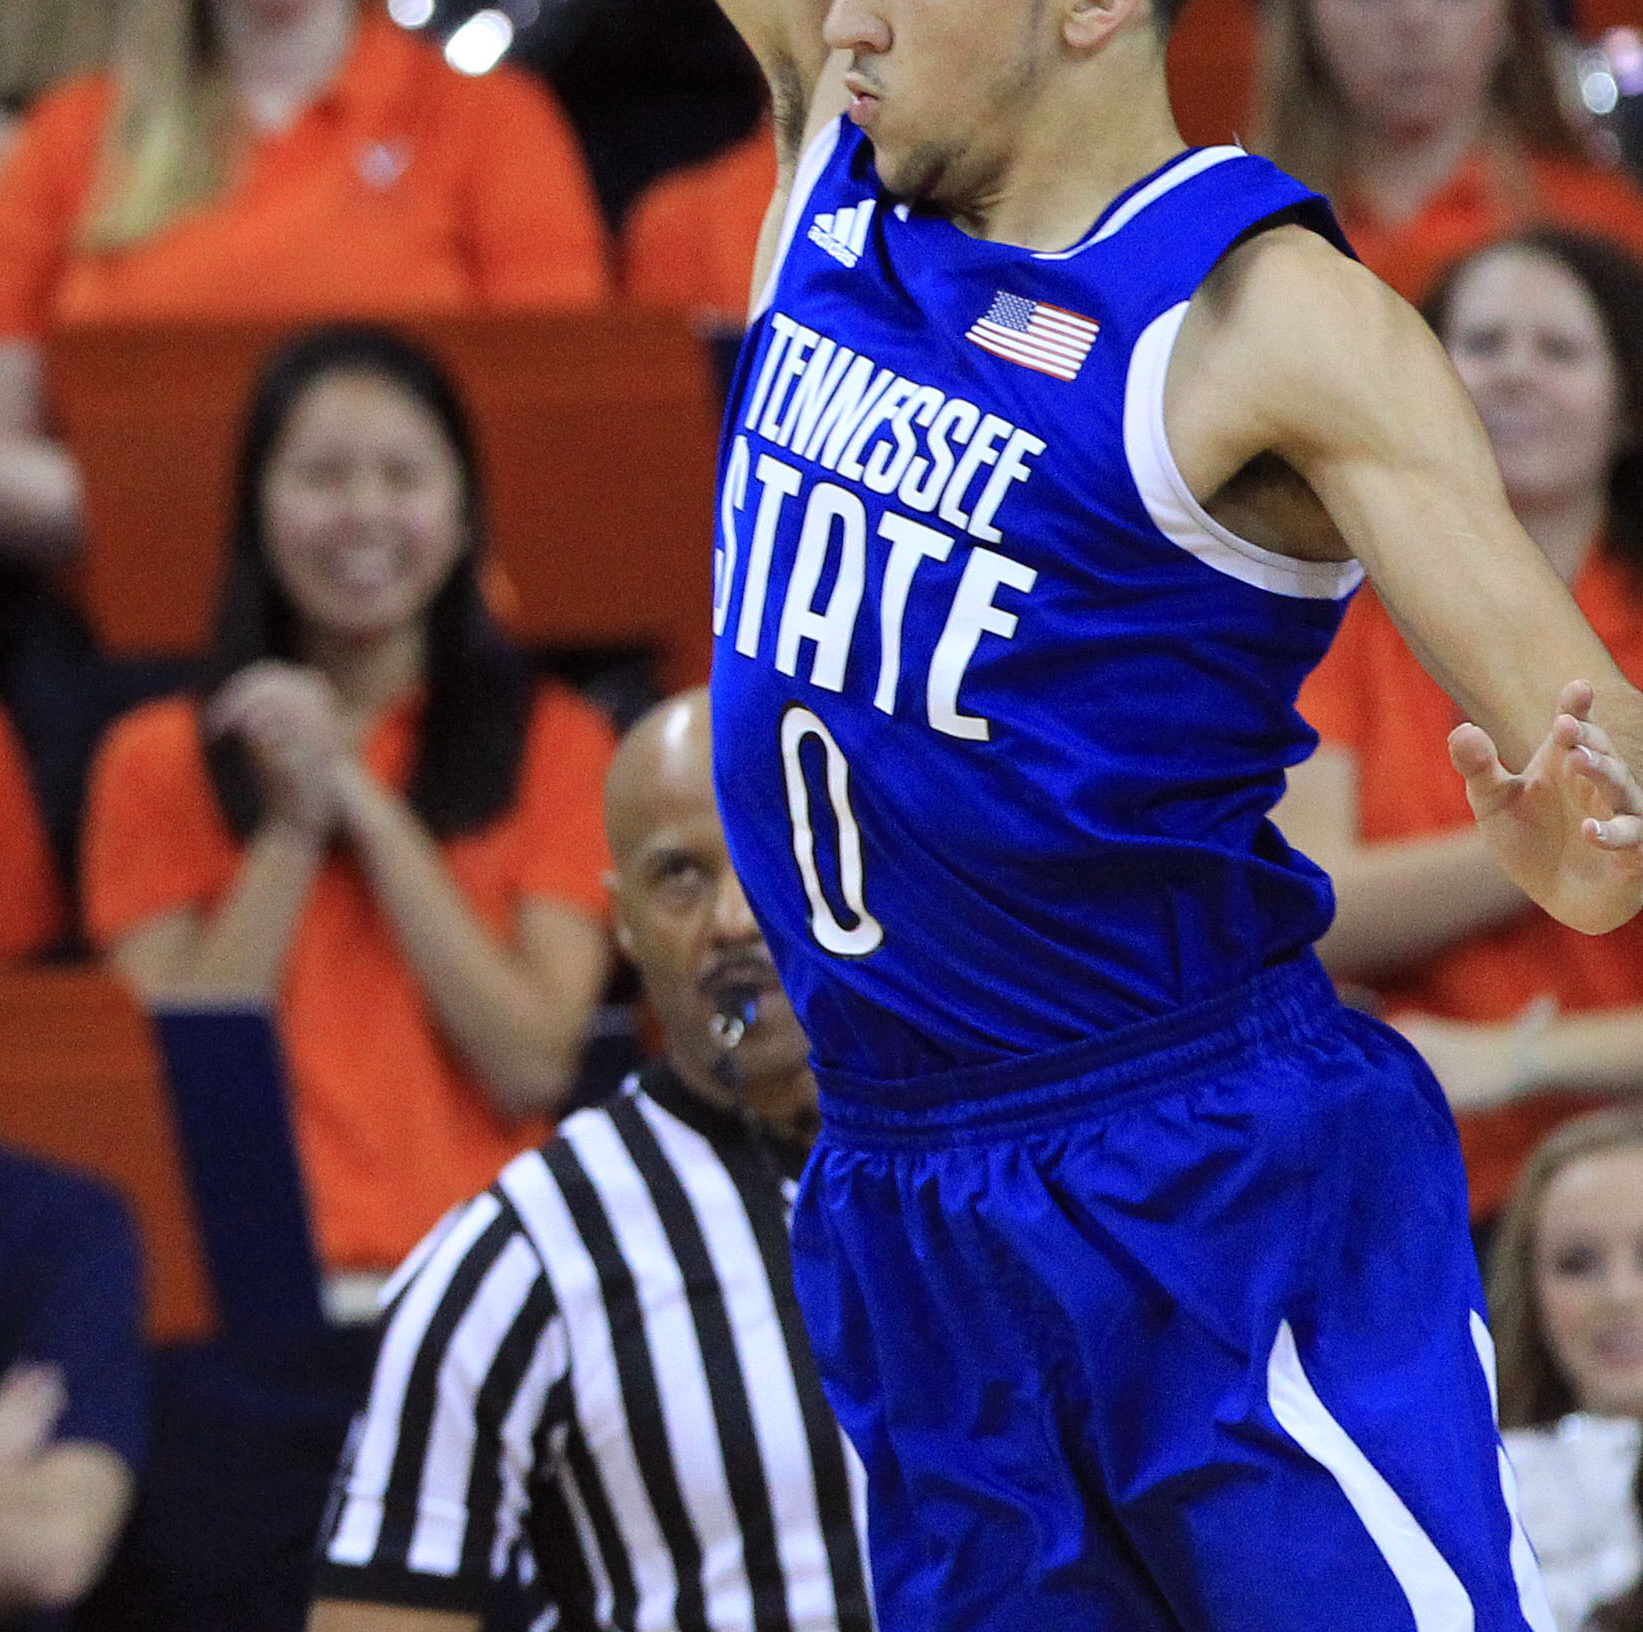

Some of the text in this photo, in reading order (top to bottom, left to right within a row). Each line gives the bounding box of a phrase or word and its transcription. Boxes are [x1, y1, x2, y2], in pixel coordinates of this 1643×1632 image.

[744, 312, 1048, 544] TENNESSEE
[713, 434, 1039, 742] STATE
[778, 699, 885, 959] 0
